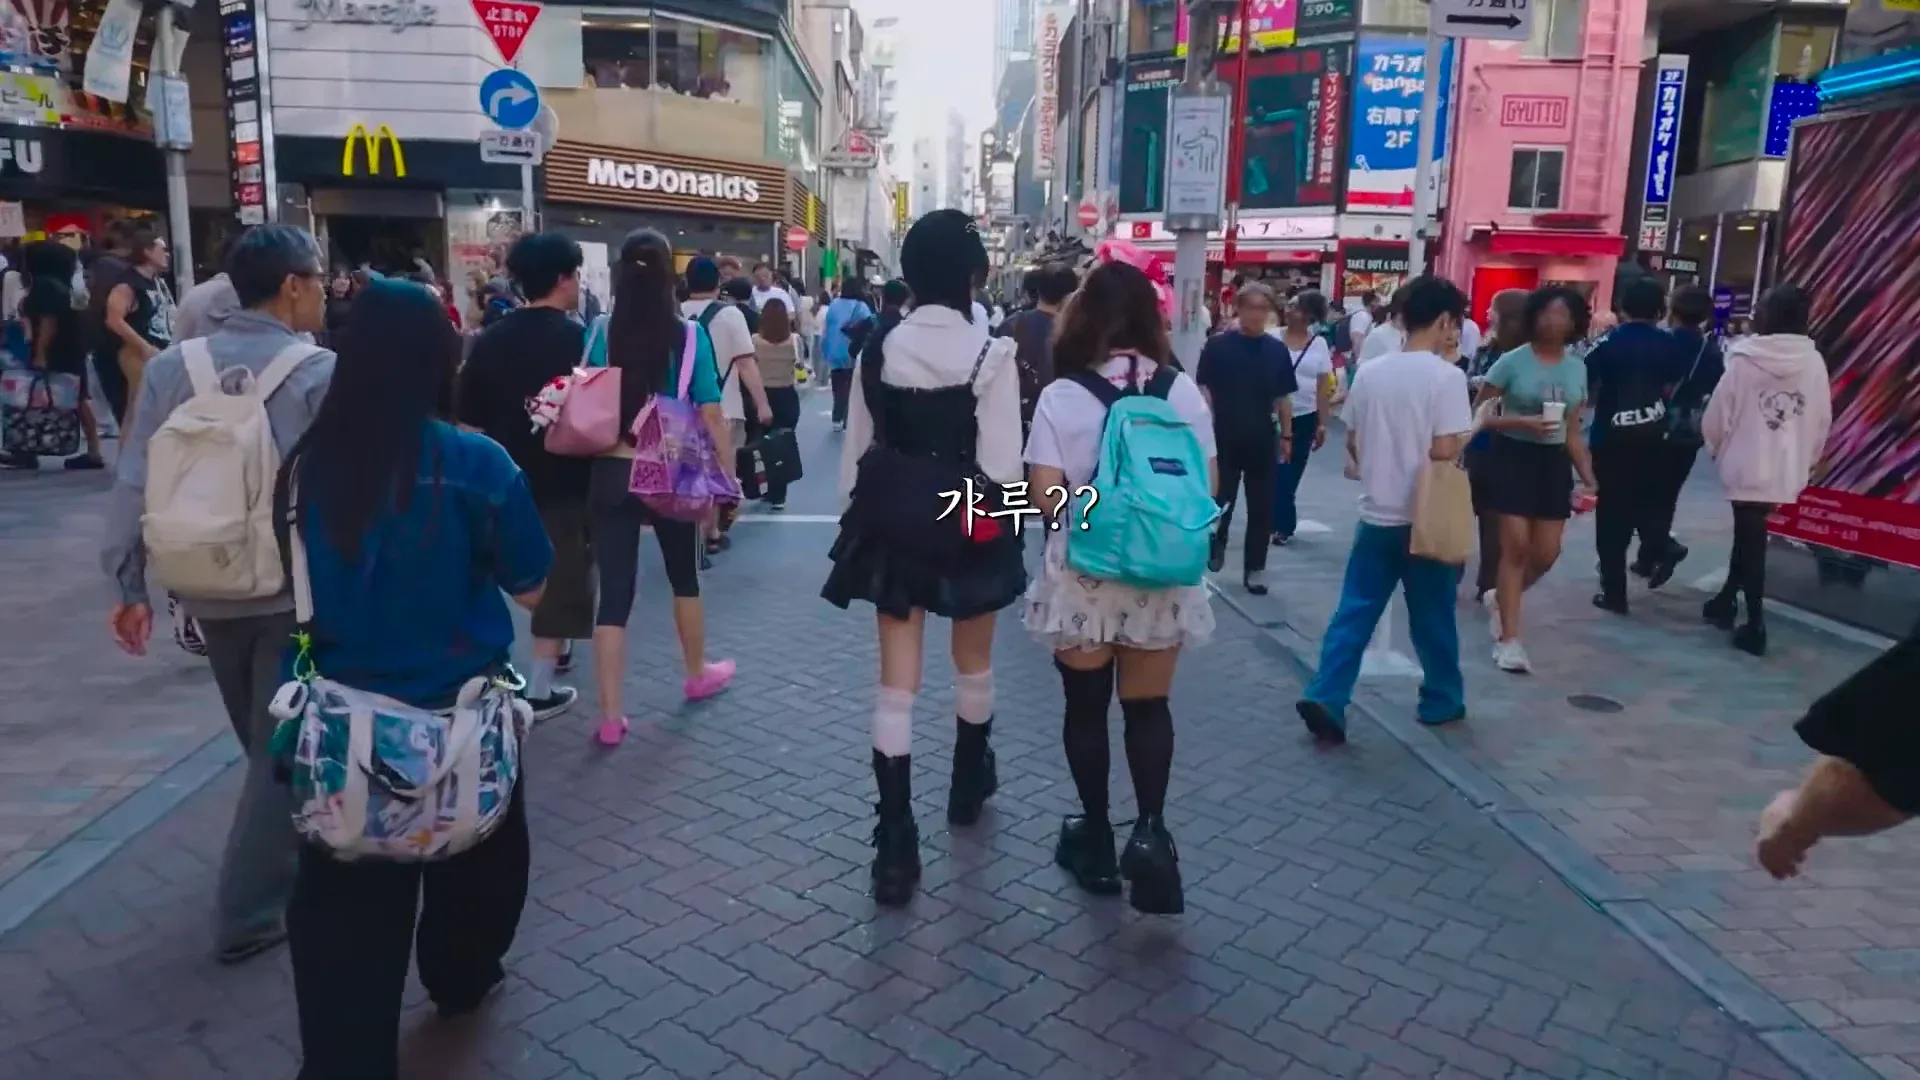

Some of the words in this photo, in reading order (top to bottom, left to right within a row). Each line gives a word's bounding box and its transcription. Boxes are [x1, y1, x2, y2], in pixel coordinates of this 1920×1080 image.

[485, 6, 529, 23] 止まれ
[493, 24, 524, 38] STOP
[1507, 101, 1562, 123] GYUTTO
[1657, 86, 1678, 147] カラオケ
[1384, 130, 1413, 148] 2F
[588, 157, 760, 203] McDonald's
